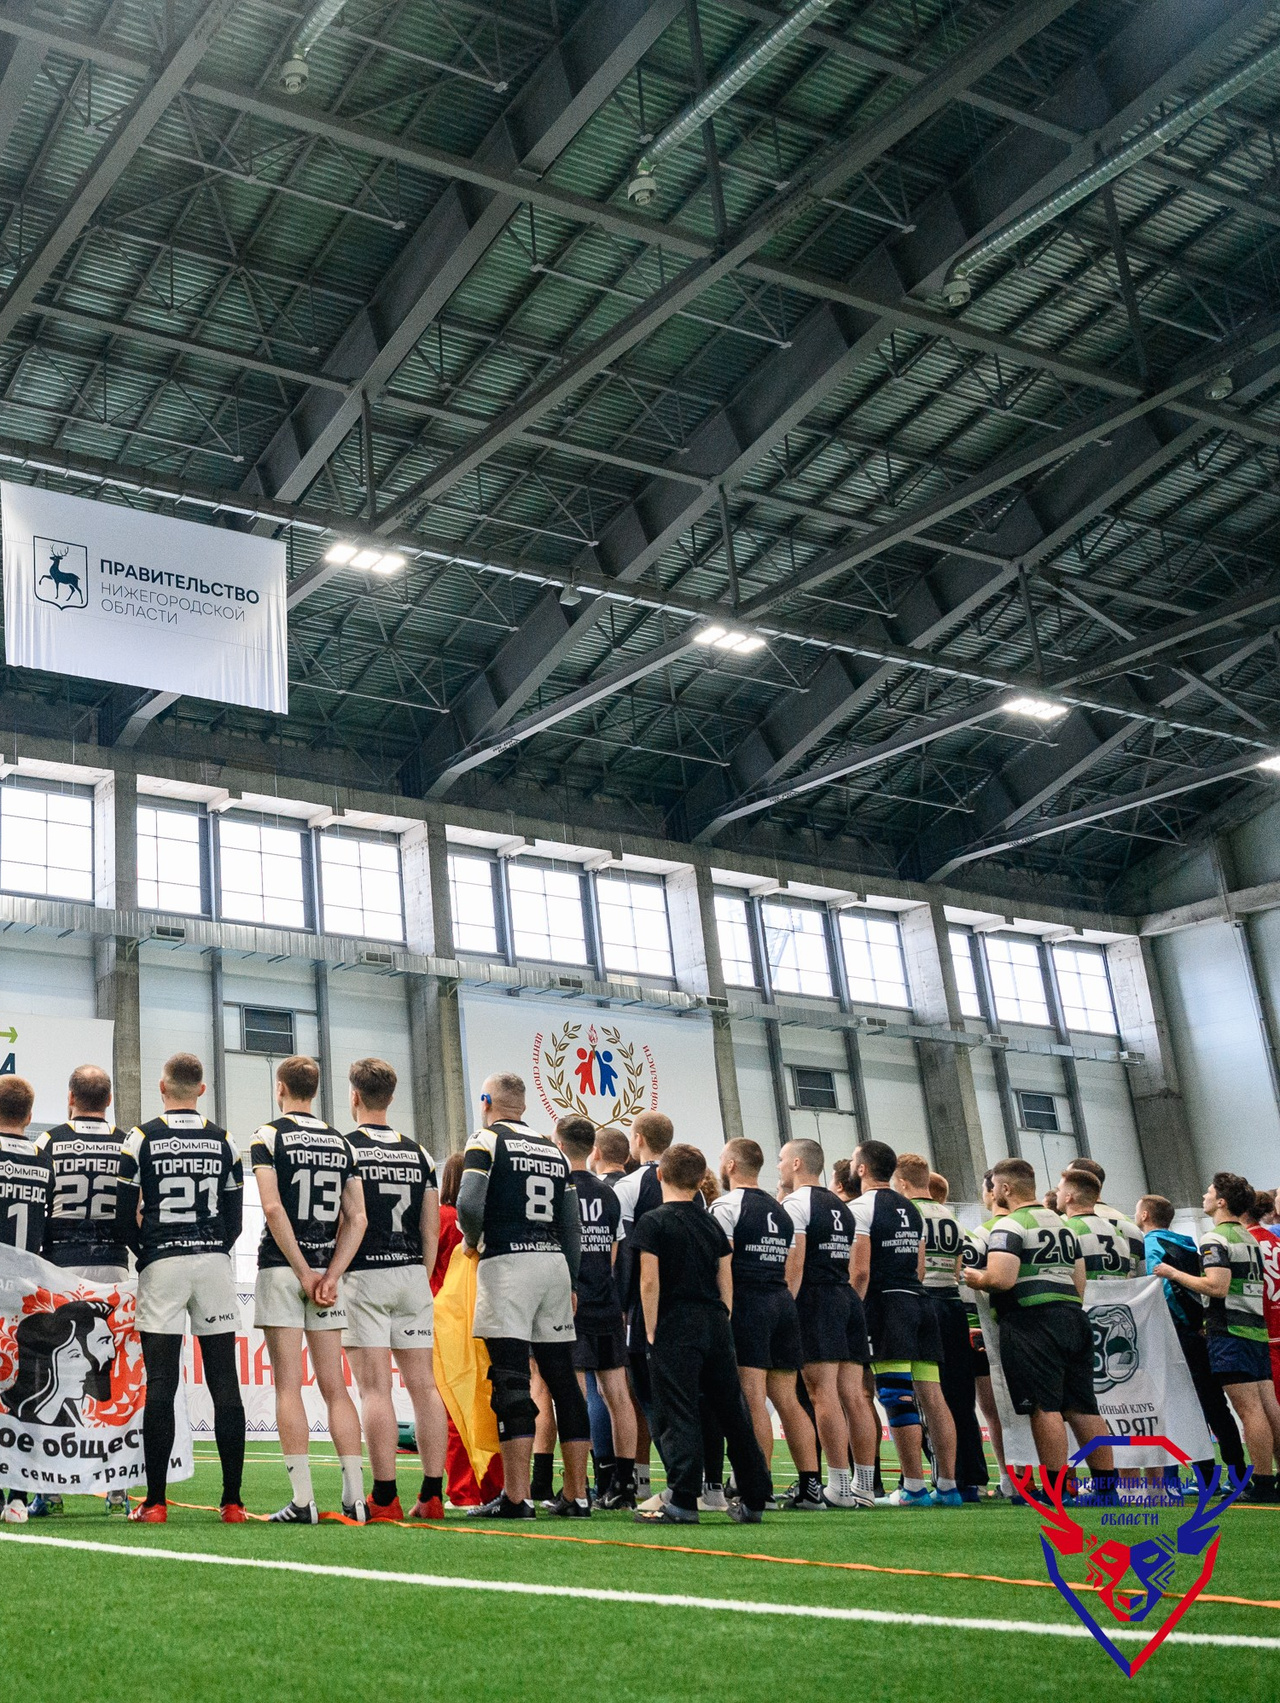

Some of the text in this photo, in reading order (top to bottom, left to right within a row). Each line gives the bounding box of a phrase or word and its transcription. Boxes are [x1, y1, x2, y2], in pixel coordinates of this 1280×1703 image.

[100, 558, 260, 605] ПРАВИТЕЛЬСТВО
[100, 582, 246, 622] НИЖЕГОРОДСКОЙ
[101, 599, 178, 625] ОБЛАСТИ
[152, 1158, 222, 1175] ТОРПЕДО
[286, 1150, 348, 1169] ТОРПЕДО
[359, 1165, 422, 1183] ТОРПЕДО
[510, 1157, 565, 1178] ТОРПЕДО
[51, 1174, 118, 1220] 22
[158, 1176, 219, 1223] 21
[291, 1168, 342, 1222] 13
[378, 1182, 412, 1232] 7
[525, 1175, 554, 1222] 8
[579, 1198, 603, 1222] 10
[7, 1202, 29, 1250] 1
[767, 1211, 779, 1234] 6
[830, 1209, 844, 1232] 8
[896, 1208, 910, 1228] 3
[925, 1217, 959, 1253] 10
[1031, 1228, 1075, 1266] 20
[1096, 1234, 1122, 1272] 3
[1129, 1402, 1155, 1414] КЛУБ
[21, 1462, 81, 1485] семья
